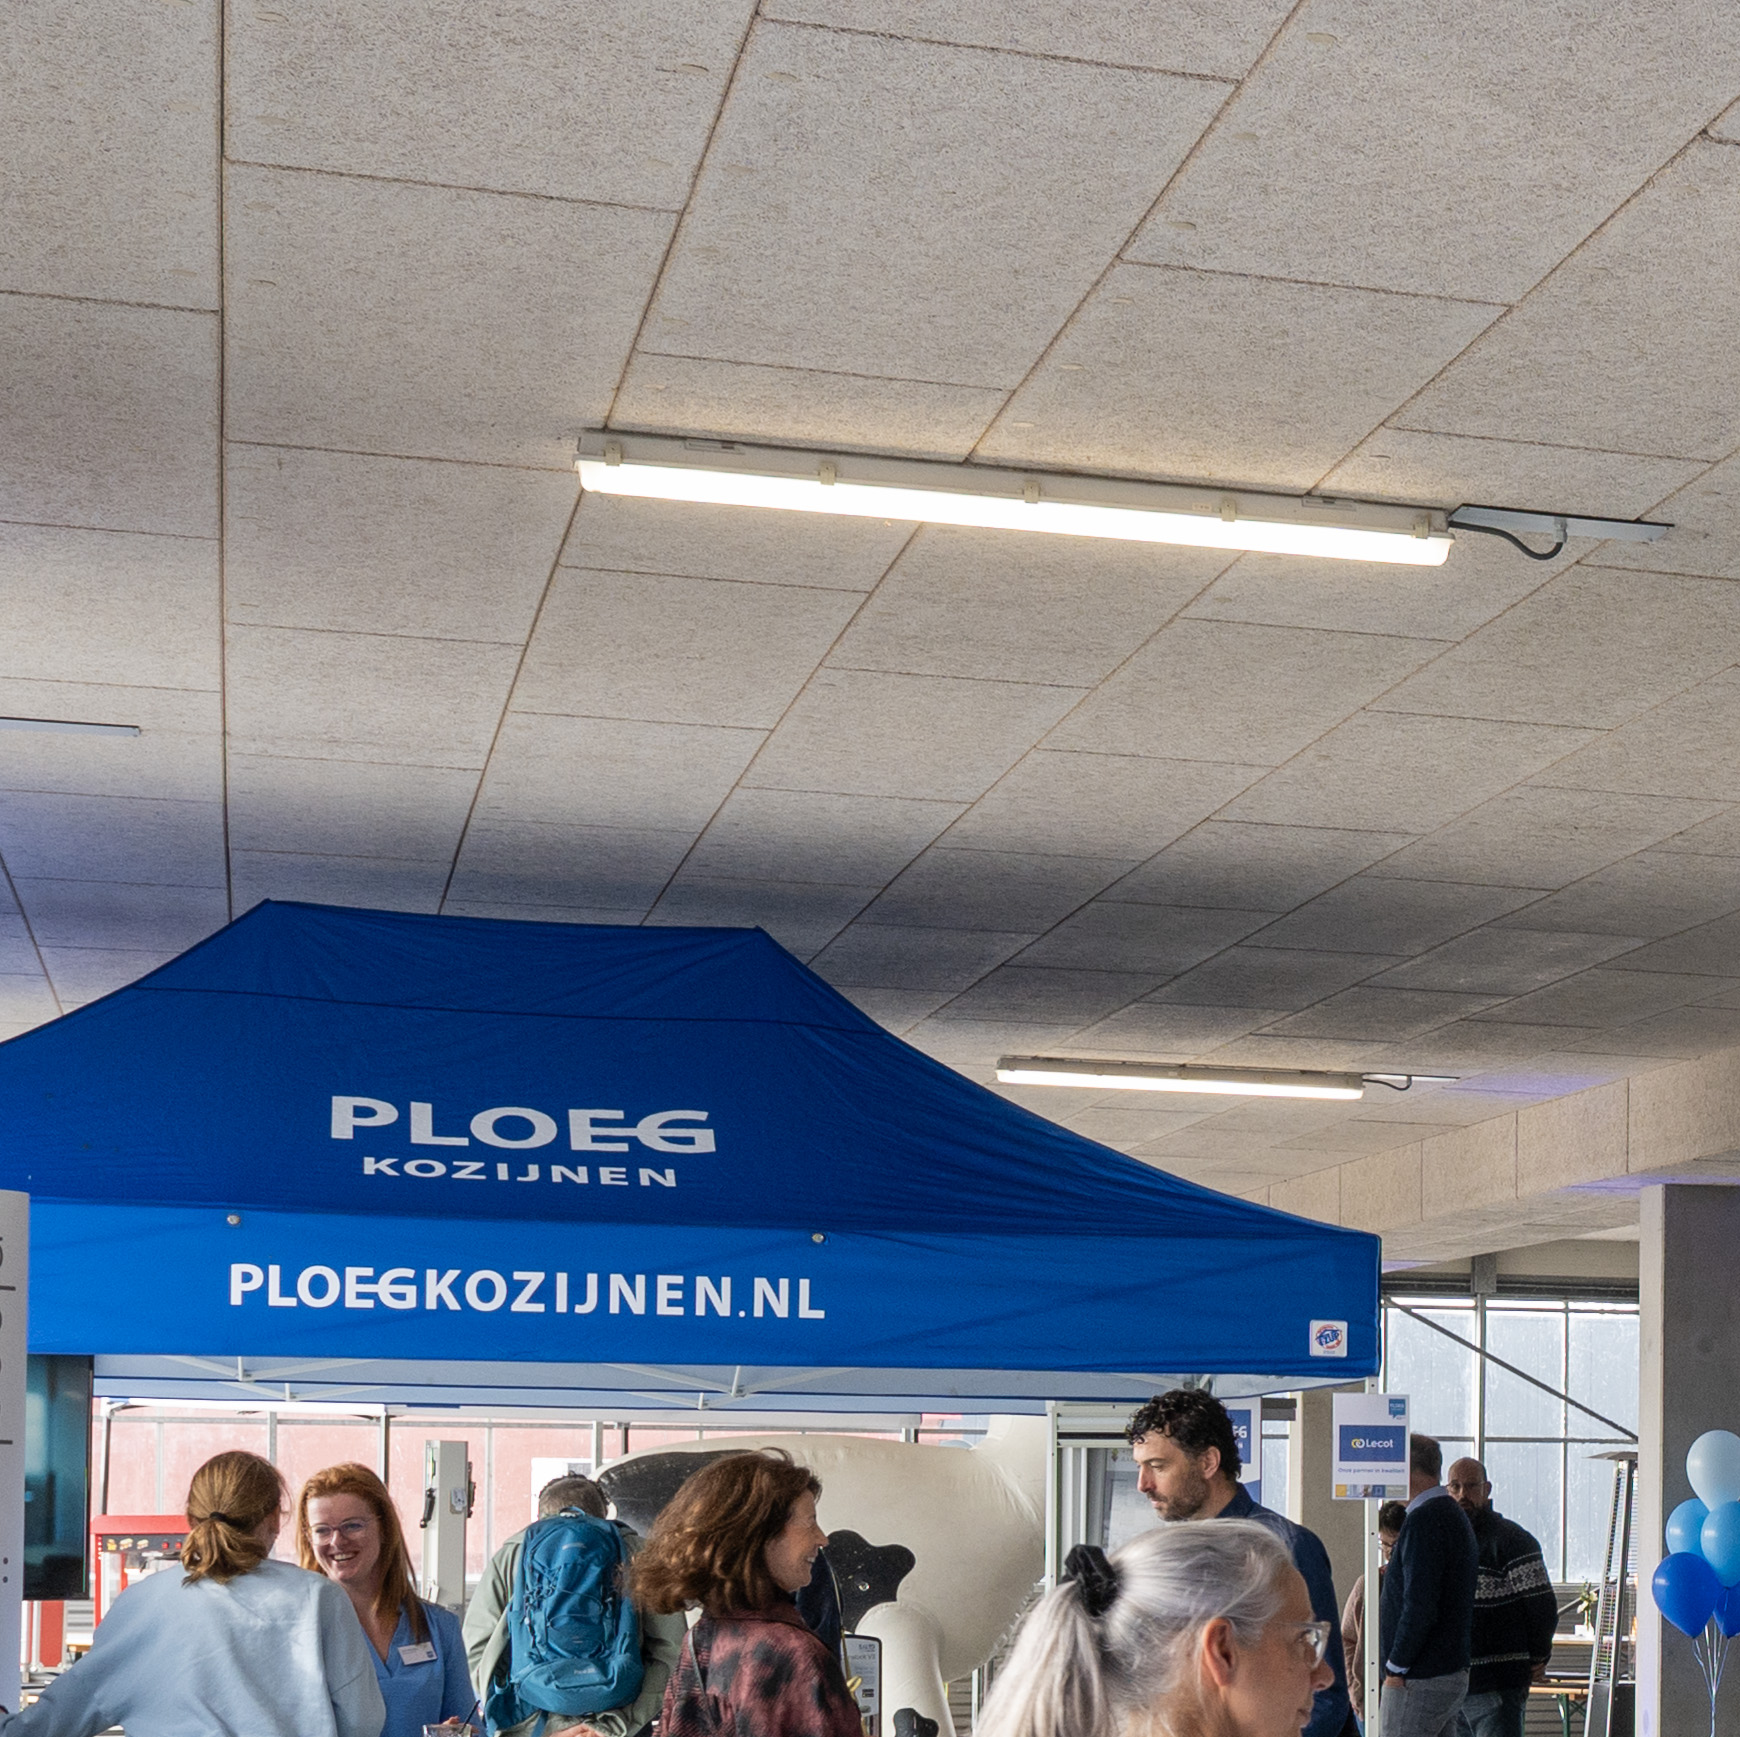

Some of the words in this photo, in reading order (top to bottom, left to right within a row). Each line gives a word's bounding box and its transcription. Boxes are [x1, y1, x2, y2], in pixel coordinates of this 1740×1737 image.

[331, 1095, 716, 1154] PLOEG
[363, 1156, 677, 1188] KOZIJNEN
[230, 1263, 826, 1320] PLOEGKOZIJNEN.NL
[1366, 1438, 1394, 1448] Lecot
